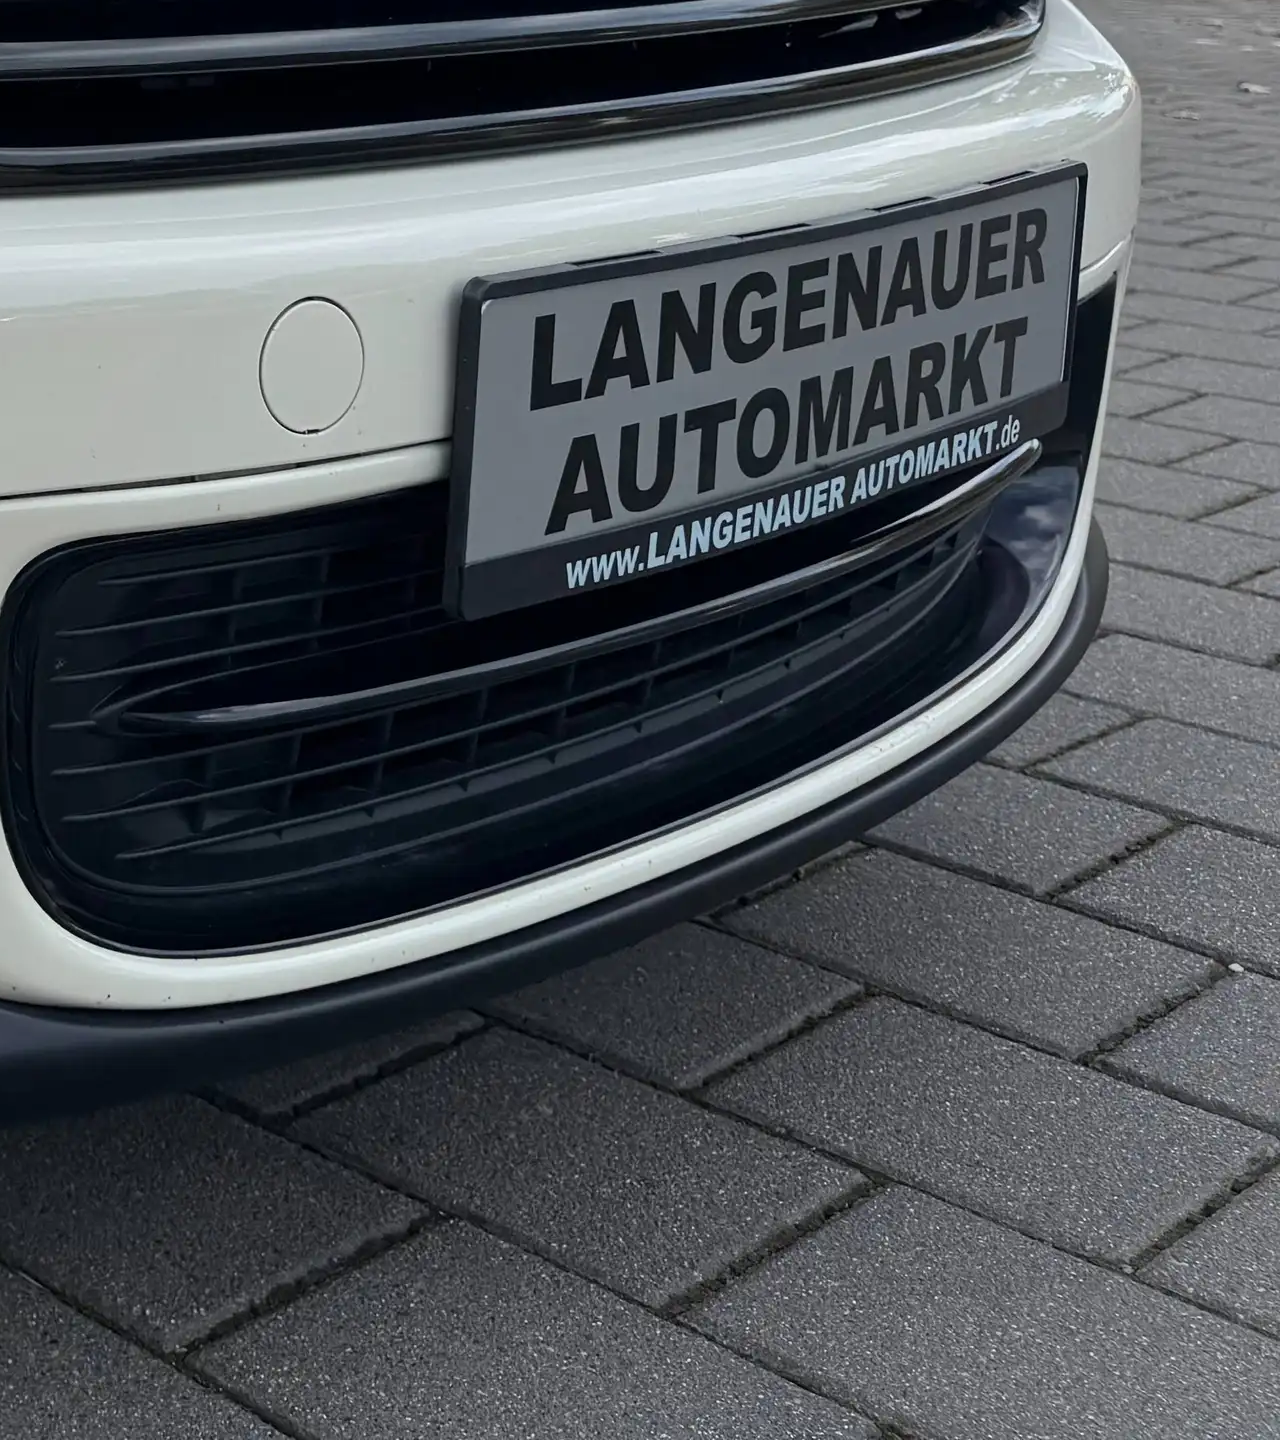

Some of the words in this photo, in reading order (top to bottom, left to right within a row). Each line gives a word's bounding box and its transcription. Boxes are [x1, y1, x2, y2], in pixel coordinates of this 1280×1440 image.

[530, 208, 1048, 412] LANGENAUER
[544, 316, 1029, 536] AUTOMARKT
[566, 475, 845, 589] www.LANGENAUER
[850, 415, 1021, 505] AUTOMARKT.de
